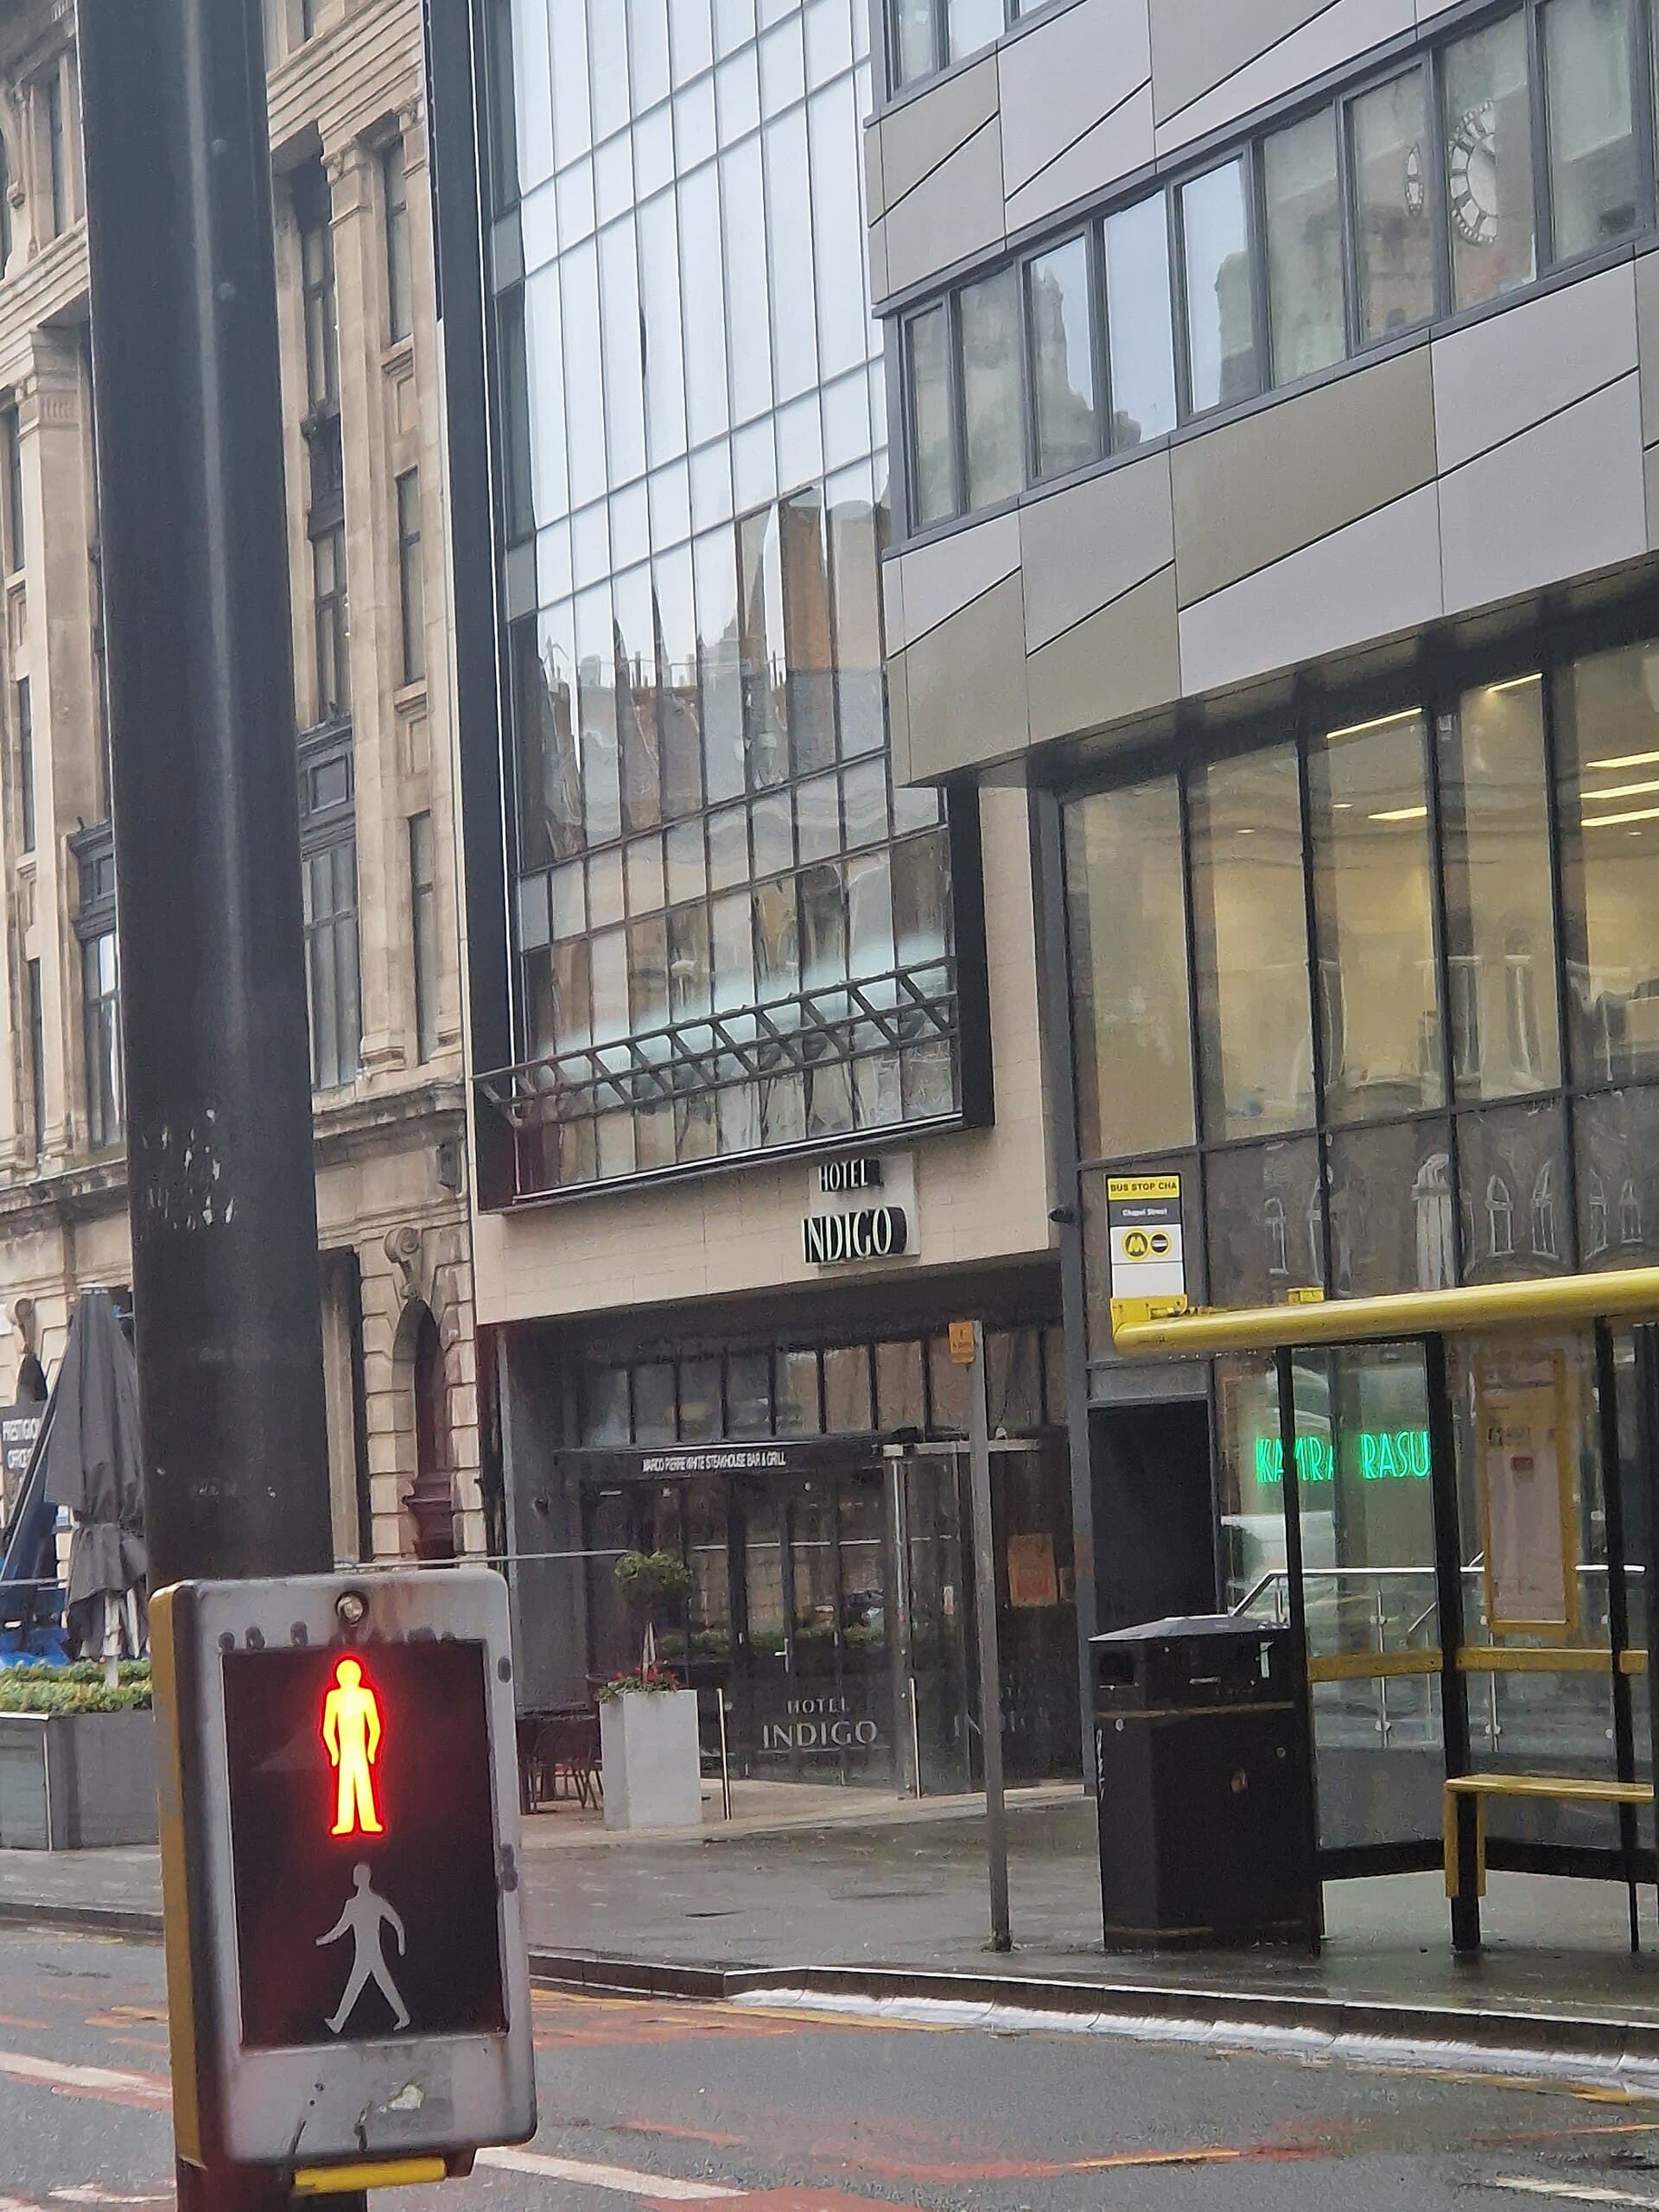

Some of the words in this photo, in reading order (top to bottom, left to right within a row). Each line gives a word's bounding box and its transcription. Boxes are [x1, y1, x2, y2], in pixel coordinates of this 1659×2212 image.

[818, 1158, 868, 1192] HOTEL
[1110, 1183, 1128, 1192] BUS
[1131, 1182, 1155, 1192] STOP
[802, 1206, 893, 1263] INDIGO
[705, 1452, 746, 1470] STEAKHOUSE
[747, 1452, 760, 1467] BAR
[766, 1451, 786, 1466] GRILL
[760, 1719, 879, 1750] INDIGO
